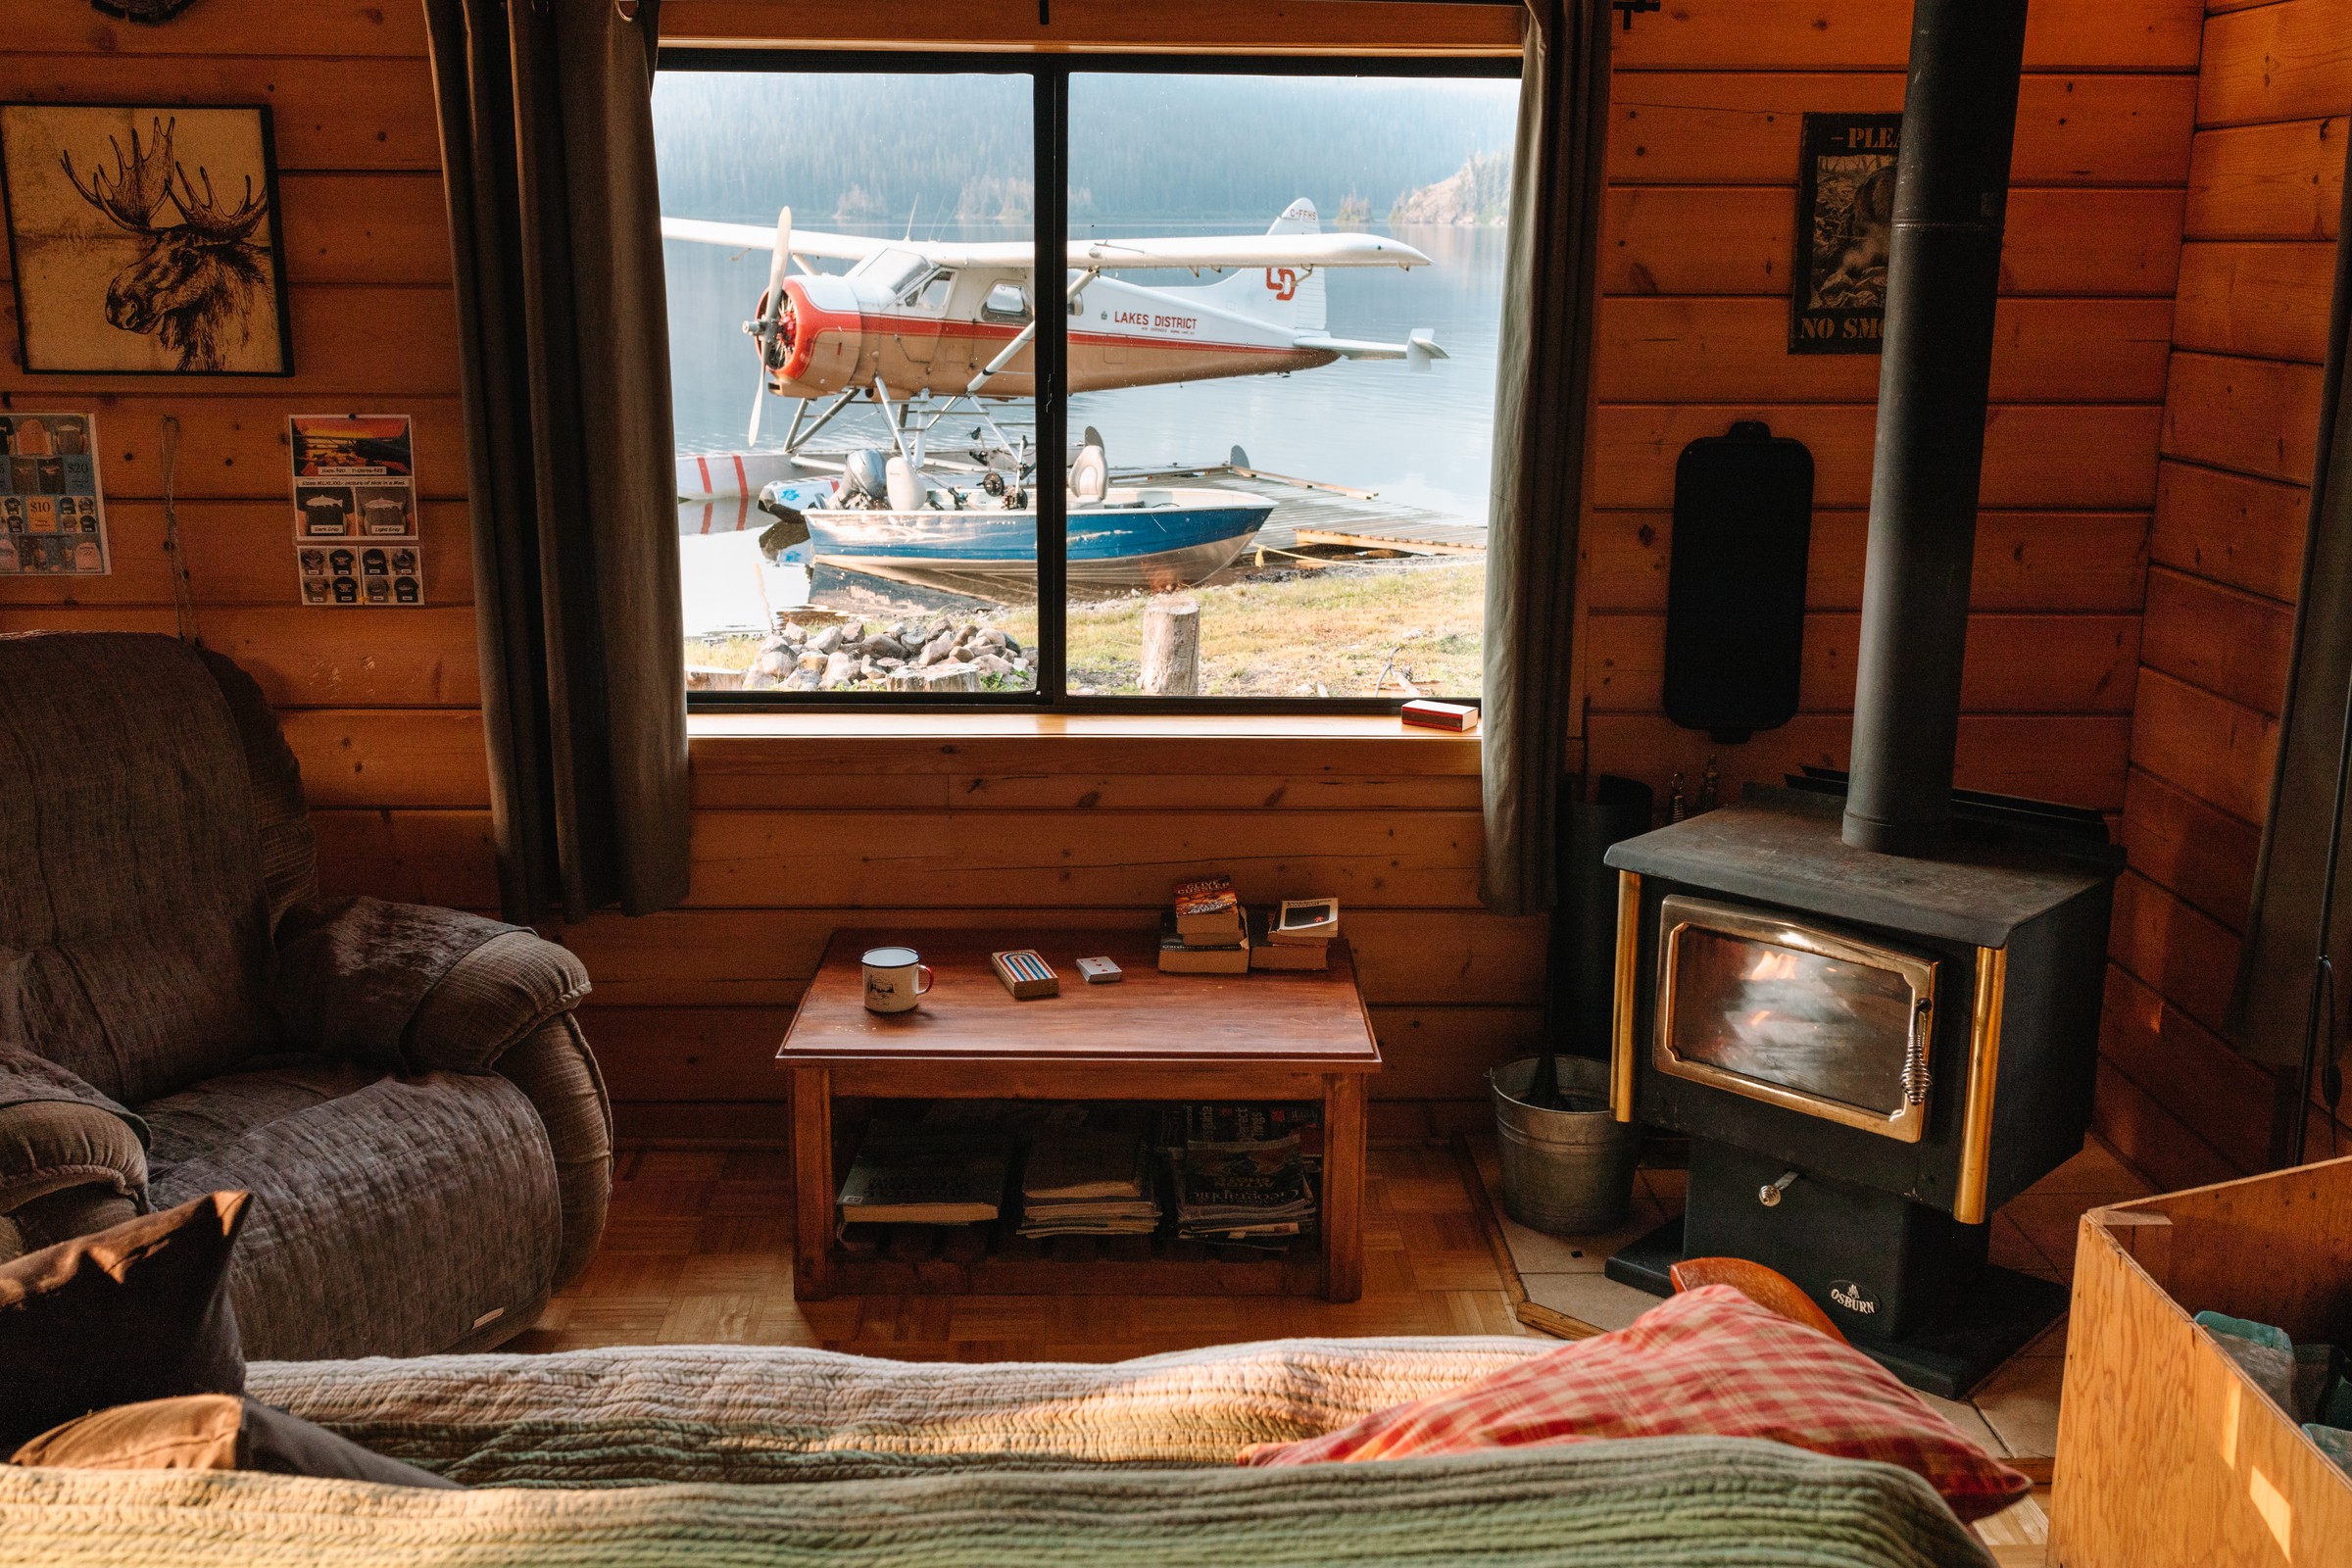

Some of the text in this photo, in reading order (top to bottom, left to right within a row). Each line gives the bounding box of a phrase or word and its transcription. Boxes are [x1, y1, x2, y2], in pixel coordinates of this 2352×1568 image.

[1290, 208, 1317, 221] C-FFHS
[1114, 311, 1198, 329] LAKES DISTRICT
[1800, 318, 1836, 339] NO
[68, 463, 89, 473] $20
[30, 501, 51, 513] $10
[1830, 1288, 1876, 1314] OSBURN
